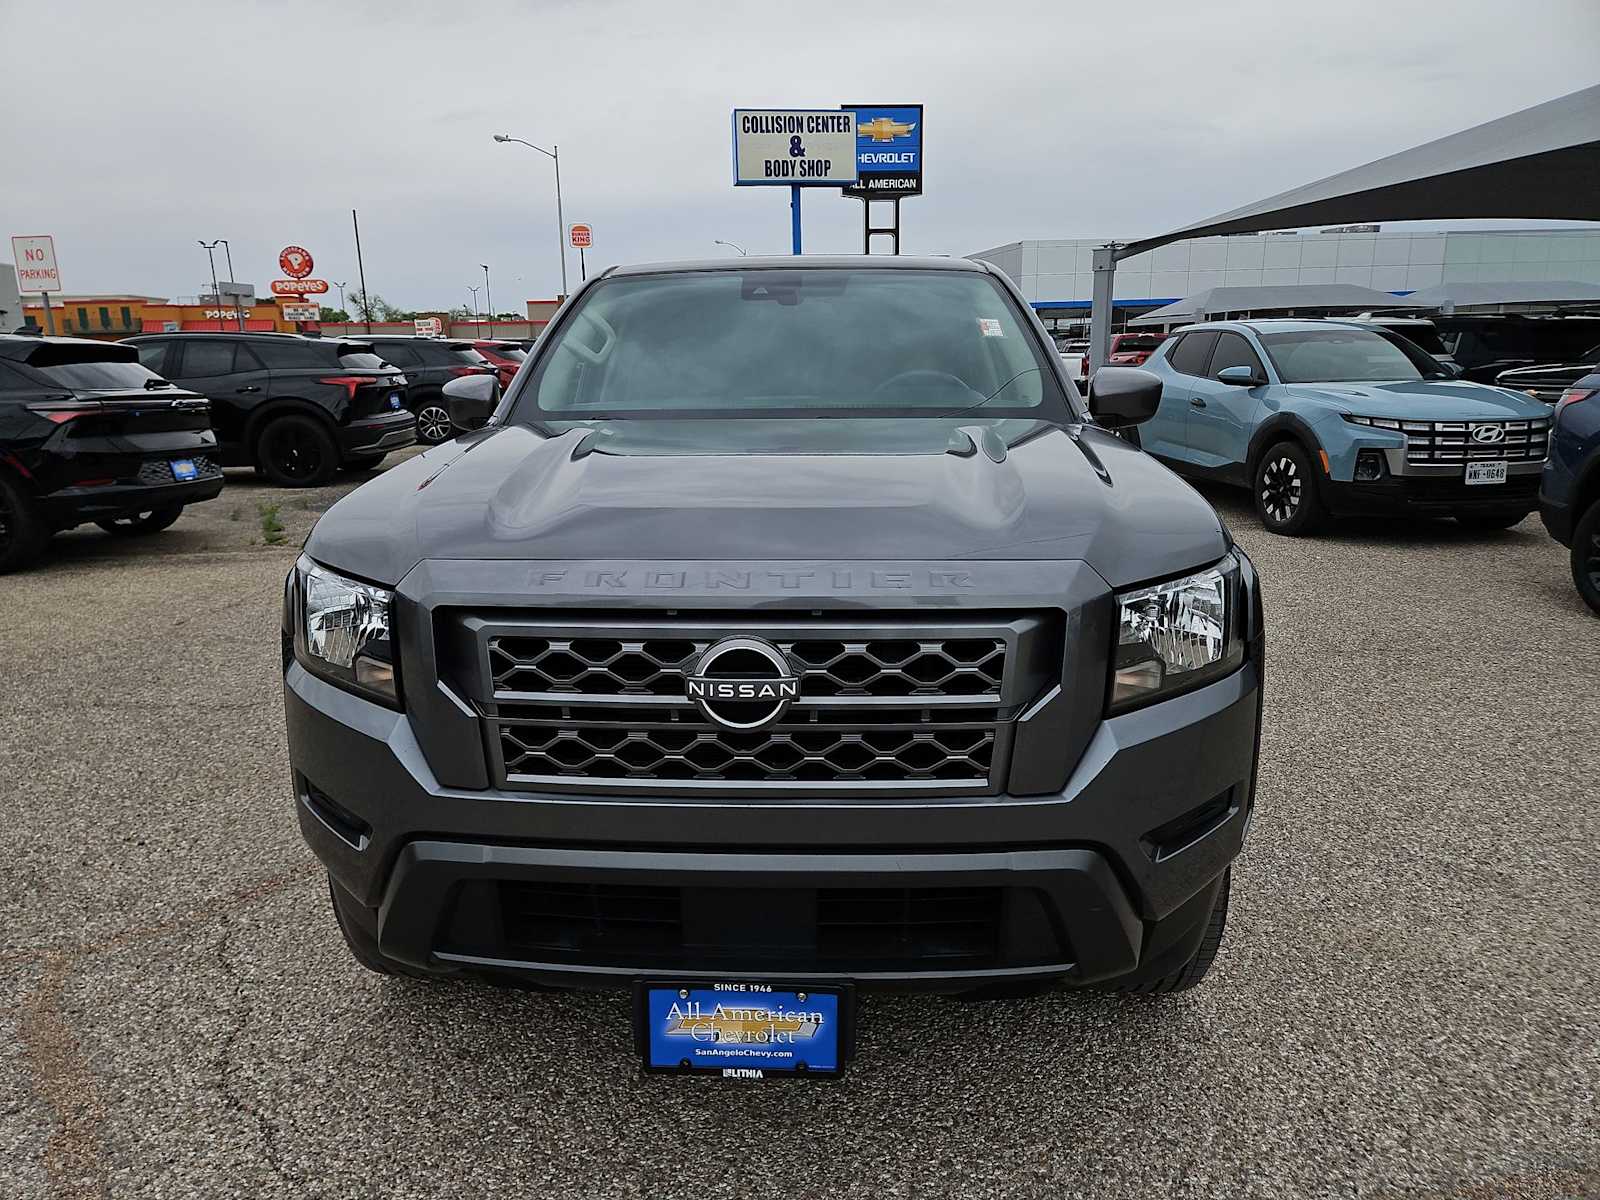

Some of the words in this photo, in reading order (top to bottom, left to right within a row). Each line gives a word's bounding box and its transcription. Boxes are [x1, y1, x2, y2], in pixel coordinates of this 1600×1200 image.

[742, 115, 803, 134] COLLISION
[807, 115, 851, 133] CENTER
[789, 135, 806, 157] &
[857, 152, 916, 164] HEVROLET
[764, 159, 796, 177] BODY
[799, 159, 831, 177] SHOP
[868, 179, 917, 189] AMERICAN
[25, 248, 44, 261] NO
[20, 268, 56, 279] PARKING
[528, 568, 976, 589] FRONTIER
[687, 681, 798, 698] NISSAN
[714, 984, 746, 992] SINCE
[749, 985, 772, 993] 1946
[665, 1001, 701, 1020] All
[710, 1002, 824, 1024] American
[691, 1022, 795, 1044] Chevrolet
[695, 1048, 793, 1058] SanAngeloChevy.com
